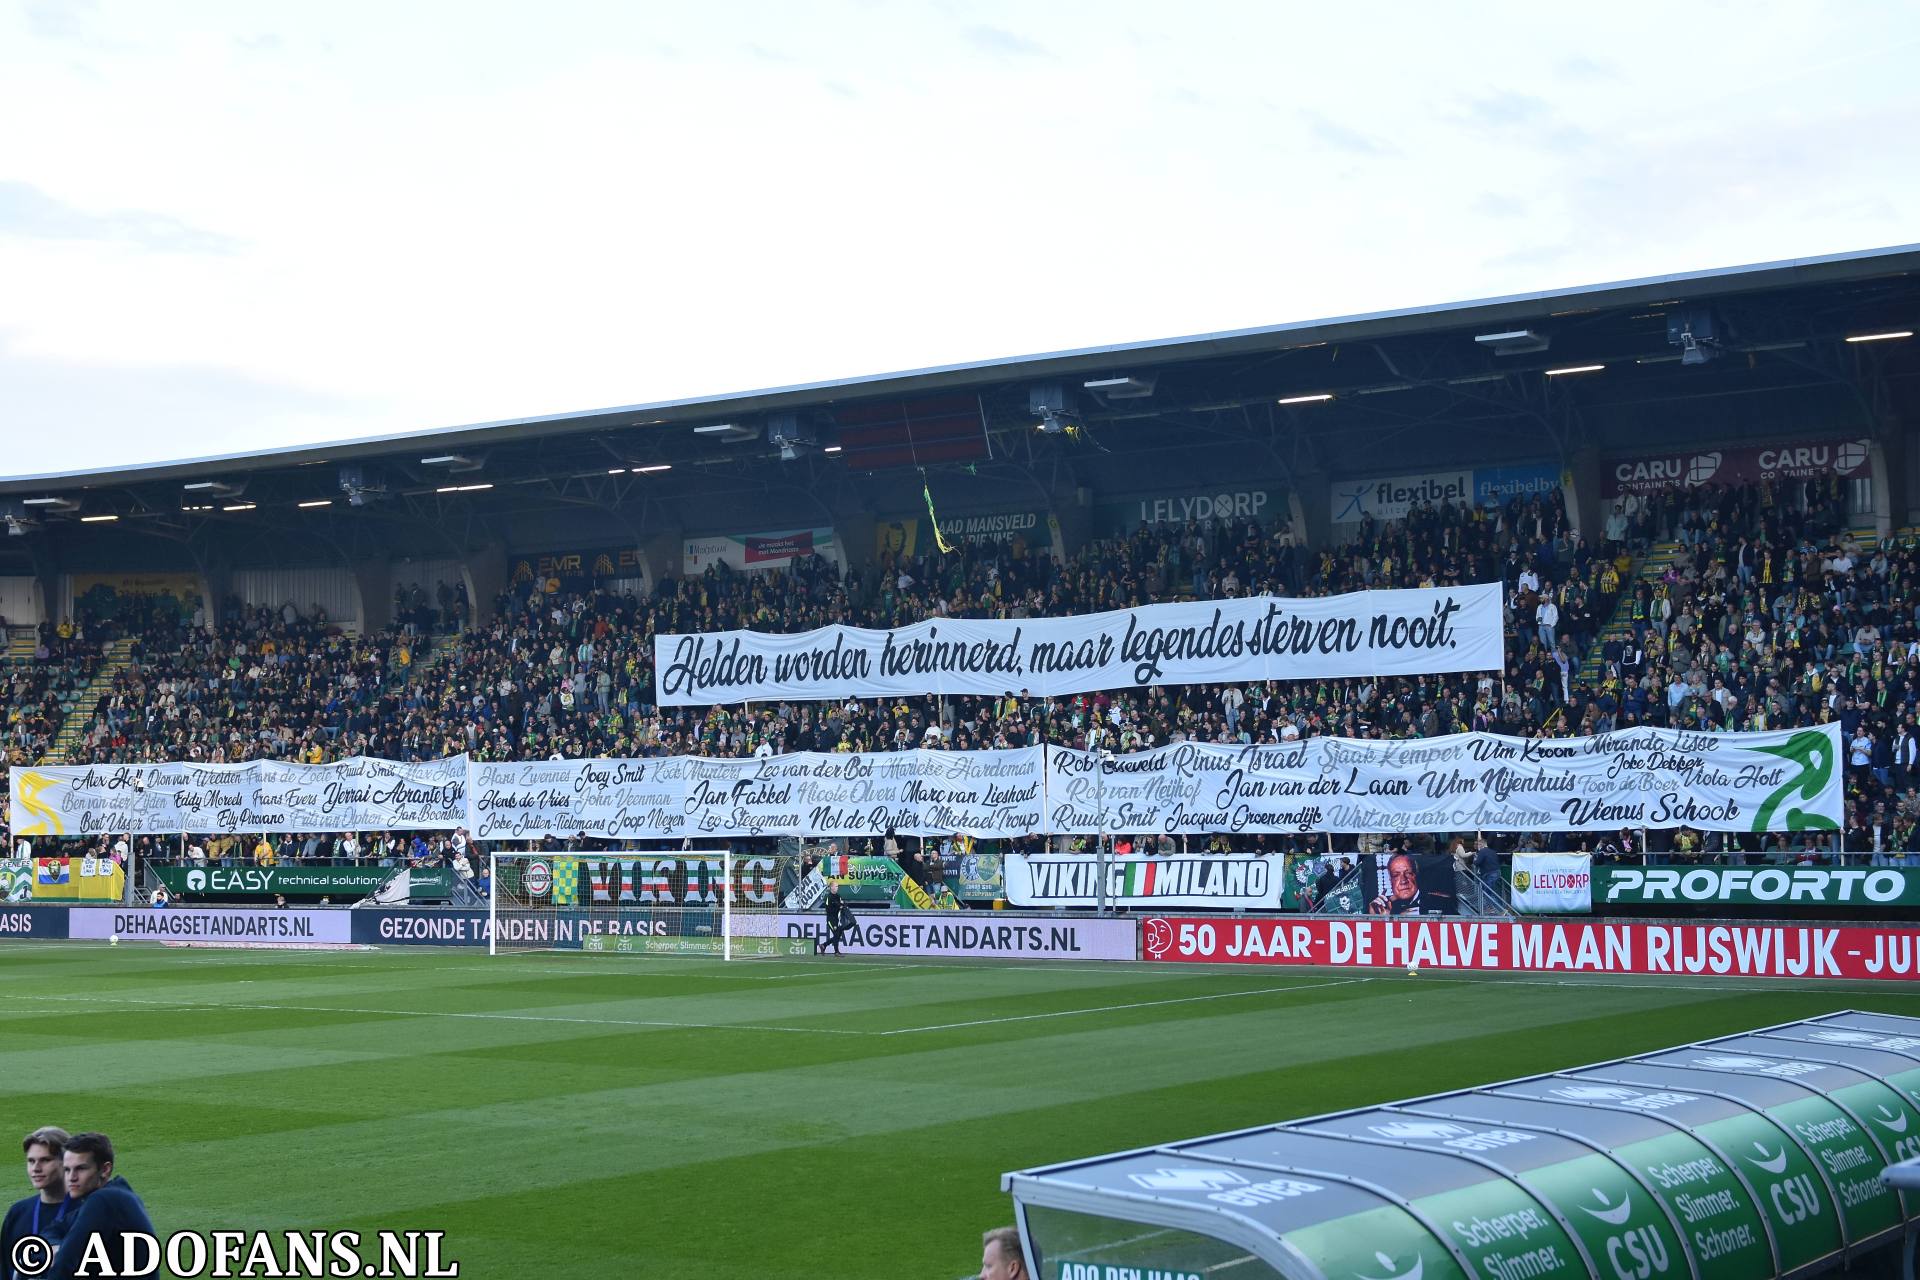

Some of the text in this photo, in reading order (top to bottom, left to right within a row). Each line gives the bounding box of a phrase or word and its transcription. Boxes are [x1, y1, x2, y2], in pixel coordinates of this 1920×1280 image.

[1616, 459, 1681, 481] CARU
[1759, 446, 1828, 469] CARU
[1377, 476, 1466, 504] flexibel
[1141, 491, 1267, 523] LELYDORP
[966, 513, 1036, 534] MANSVELD
[663, 597, 1461, 697] Helden worden herinnerd, maar legendes sterven nooit.
[1053, 751, 1095, 776] Rob
[1172, 744, 1234, 778] Rinus
[1237, 740, 1308, 773] Israel
[1317, 740, 1376, 773] Sjaak
[1377, 740, 1463, 771] Kemper
[1467, 739, 1516, 761] Wim
[1520, 739, 1576, 763] Kroon
[1584, 732, 1669, 755] Miranda
[1669, 730, 1719, 751] Lisse
[72, 768, 107, 790] Alex
[147, 769, 171, 788] Dion
[172, 775, 191, 785] van
[279, 768, 297, 783] de
[336, 761, 365, 781] Ruud
[367, 762, 397, 778] Smit
[478, 766, 515, 786] Hans
[575, 763, 609, 792] Joey
[613, 763, 646, 785] Smit
[754, 759, 781, 781] Leo
[782, 764, 810, 777] van
[812, 759, 842, 779] der
[844, 756, 873, 780] Bol
[946, 757, 1036, 780] Hardeman
[1066, 777, 1104, 804] Rob
[1108, 783, 1141, 801] van
[1216, 769, 1269, 810] Jan
[1271, 778, 1306, 797] van
[1308, 774, 1341, 796] der
[1344, 767, 1411, 797] Laan
[1417, 768, 1476, 798] Wim
[1480, 766, 1577, 801] Nijenhuis
[1617, 775, 1636, 790] de
[1681, 767, 1730, 787] Viola
[1734, 765, 1785, 788] Holt
[62, 791, 87, 812] Ben
[88, 798, 107, 810] van
[109, 793, 131, 809] der
[173, 790, 202, 813] Eddy
[252, 788, 283, 808] Frans
[285, 788, 318, 807] Evers
[372, 777, 442, 804] Abrante
[478, 789, 517, 810] Henk
[518, 792, 536, 808] de
[537, 788, 570, 810] Vries
[685, 780, 728, 814] Jan
[797, 781, 847, 805] Nicole
[901, 780, 946, 804] Marc
[947, 788, 978, 804] van
[217, 808, 238, 832] Elly
[319, 814, 340, 828] van
[387, 803, 417, 827] Jan
[607, 808, 644, 836] Joop
[698, 808, 721, 832] Leo
[809, 806, 842, 830] Nol
[844, 809, 865, 829] de
[867, 806, 921, 832] Ruiter
[924, 805, 996, 829] Michael
[997, 805, 1039, 833] Troup
[1052, 804, 1108, 831] Ruud
[1111, 802, 1160, 830] Smit
[1165, 802, 1229, 832] Jacques
[1231, 804, 1323, 832] Groenendijk
[1327, 804, 1411, 832] Whitney
[1414, 809, 1450, 826] van
[1452, 800, 1552, 826] Ardenne
[211, 870, 383, 890] EASY technical solutions
[1030, 860, 1260, 898] VIKING MILANO
[1534, 873, 1589, 889] LELYDORP
[1608, 869, 1906, 902] PROFORTO
[115, 914, 314, 937] DEHAAGSETANDARTS.NL
[380, 917, 466, 939] GEZONDE
[471, 919, 548, 941] TANDEN
[554, 920, 576, 941] IN
[609, 920, 667, 936] BASIS
[789, 946, 806, 955] CSU
[1179, 923, 1216, 956] 50
[1386, 922, 1498, 967] HALVE
[1512, 924, 1631, 970] MAAN
[1795, 1117, 1856, 1144] Scherper.
[1648, 1157, 1724, 1188] Scherper.
[1821, 1145, 1872, 1174] Slimmer.
[1675, 1189, 1740, 1223] Slimmer.
[1770, 1173, 1820, 1226] CSU
[1453, 1207, 1548, 1248] Scherper.
[1695, 1223, 1756, 1261] Schoner.
[1483, 1245, 1565, 1280] Slimmer.
[1606, 1224, 1669, 1280] CSU
[1062, 1263, 1100, 1280] ADO
